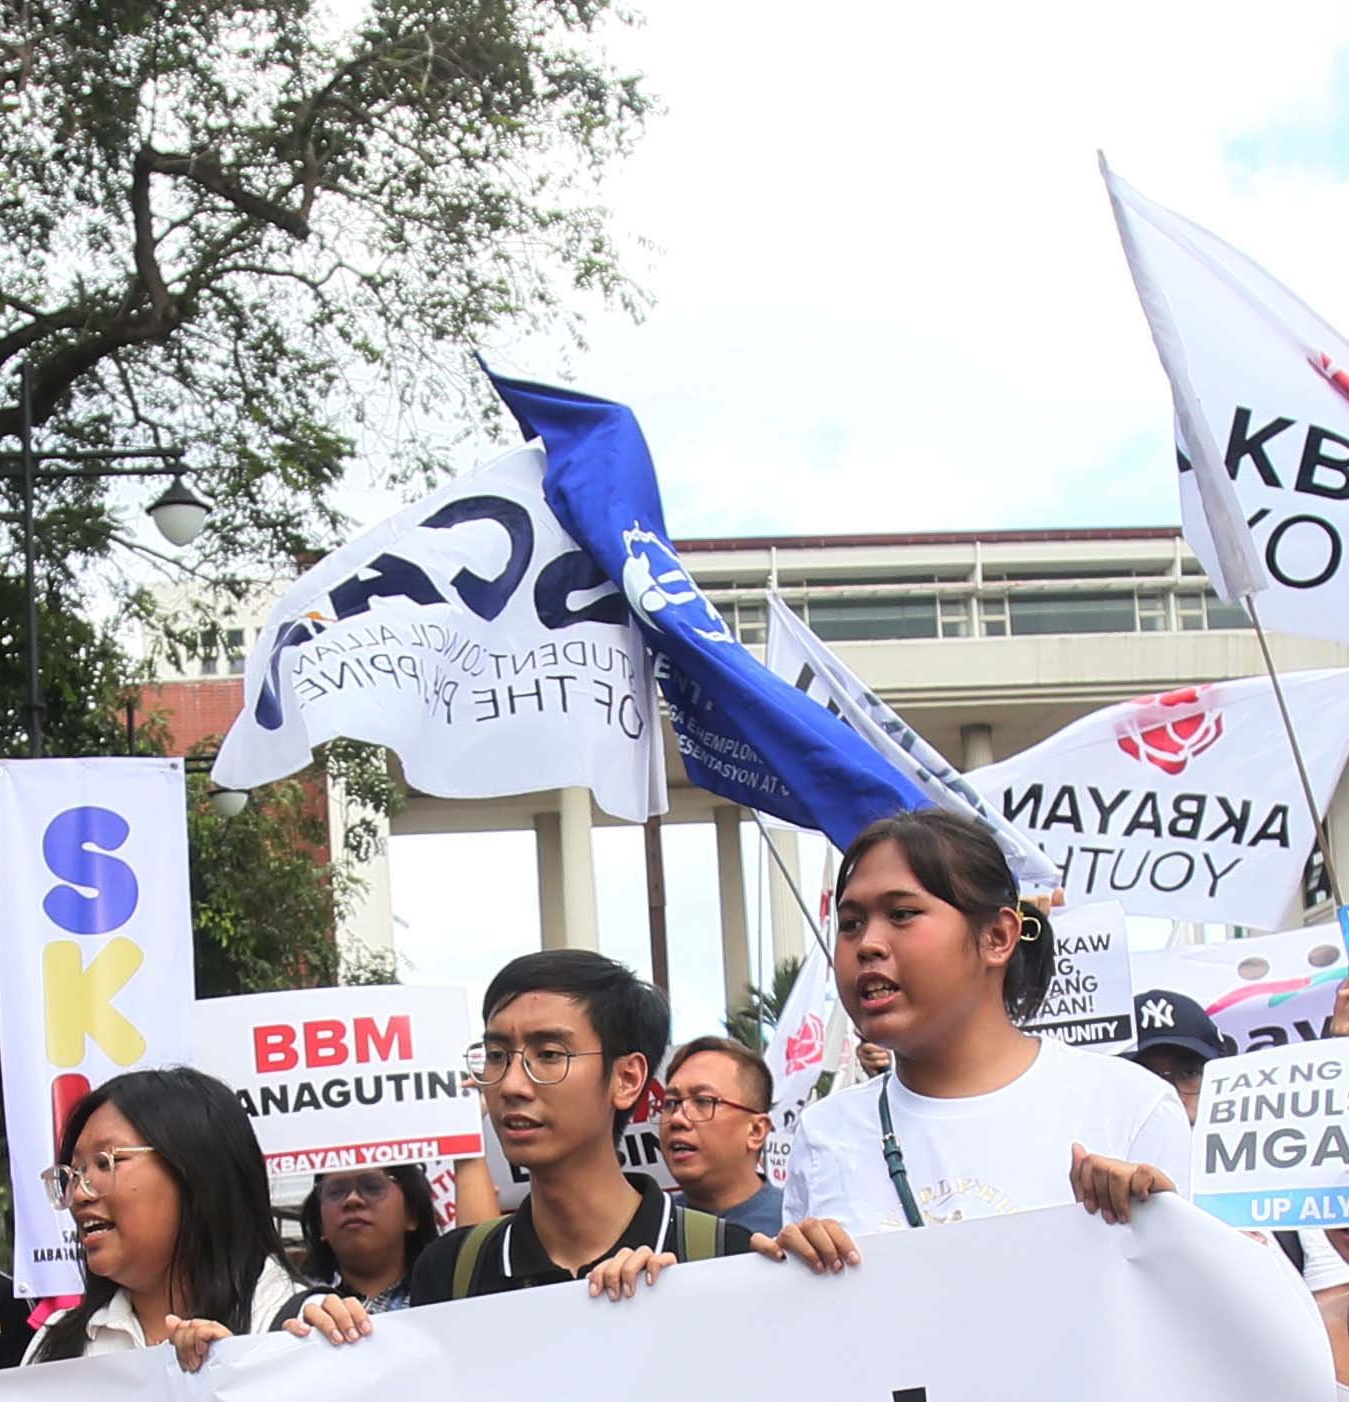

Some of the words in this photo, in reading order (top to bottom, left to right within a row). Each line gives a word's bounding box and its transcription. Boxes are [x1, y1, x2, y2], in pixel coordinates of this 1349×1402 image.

[252, 1015, 414, 1074] BBM
[235, 1070, 472, 1117] ANAGUTIN!
[1211, 1067, 1279, 1096] TAX
[1289, 1061, 1343, 1083] NG
[265, 1149, 358, 1175] KBAYAN
[363, 1141, 439, 1163] YOUTH
[1250, 1196, 1293, 1221] UP
